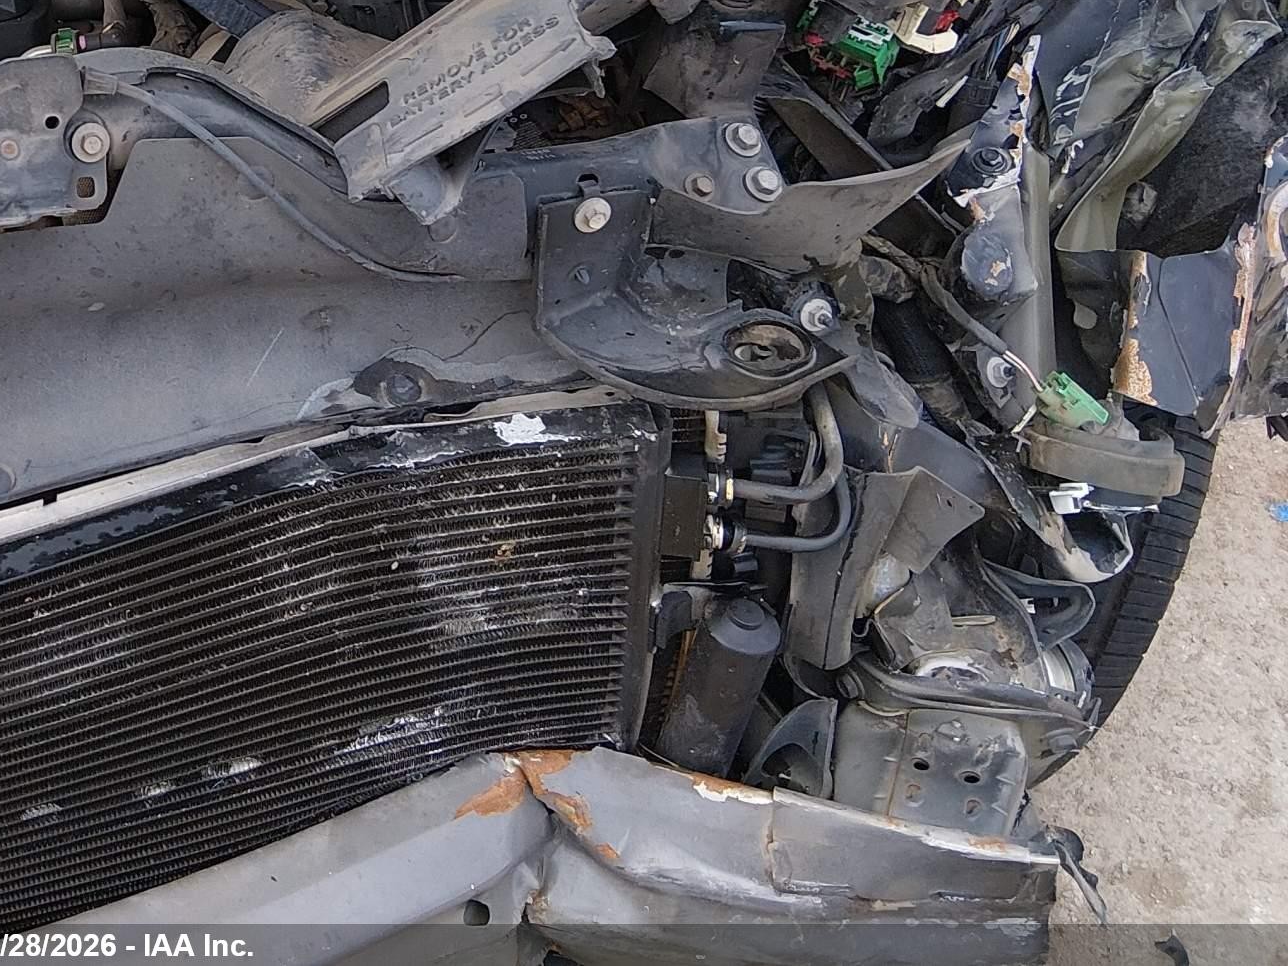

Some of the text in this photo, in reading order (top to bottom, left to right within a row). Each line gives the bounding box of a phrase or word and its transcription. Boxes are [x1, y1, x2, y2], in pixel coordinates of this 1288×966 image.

[389, 15, 560, 128] BATTERY ACCESS
[402, 16, 533, 105] REMOVE FOR
